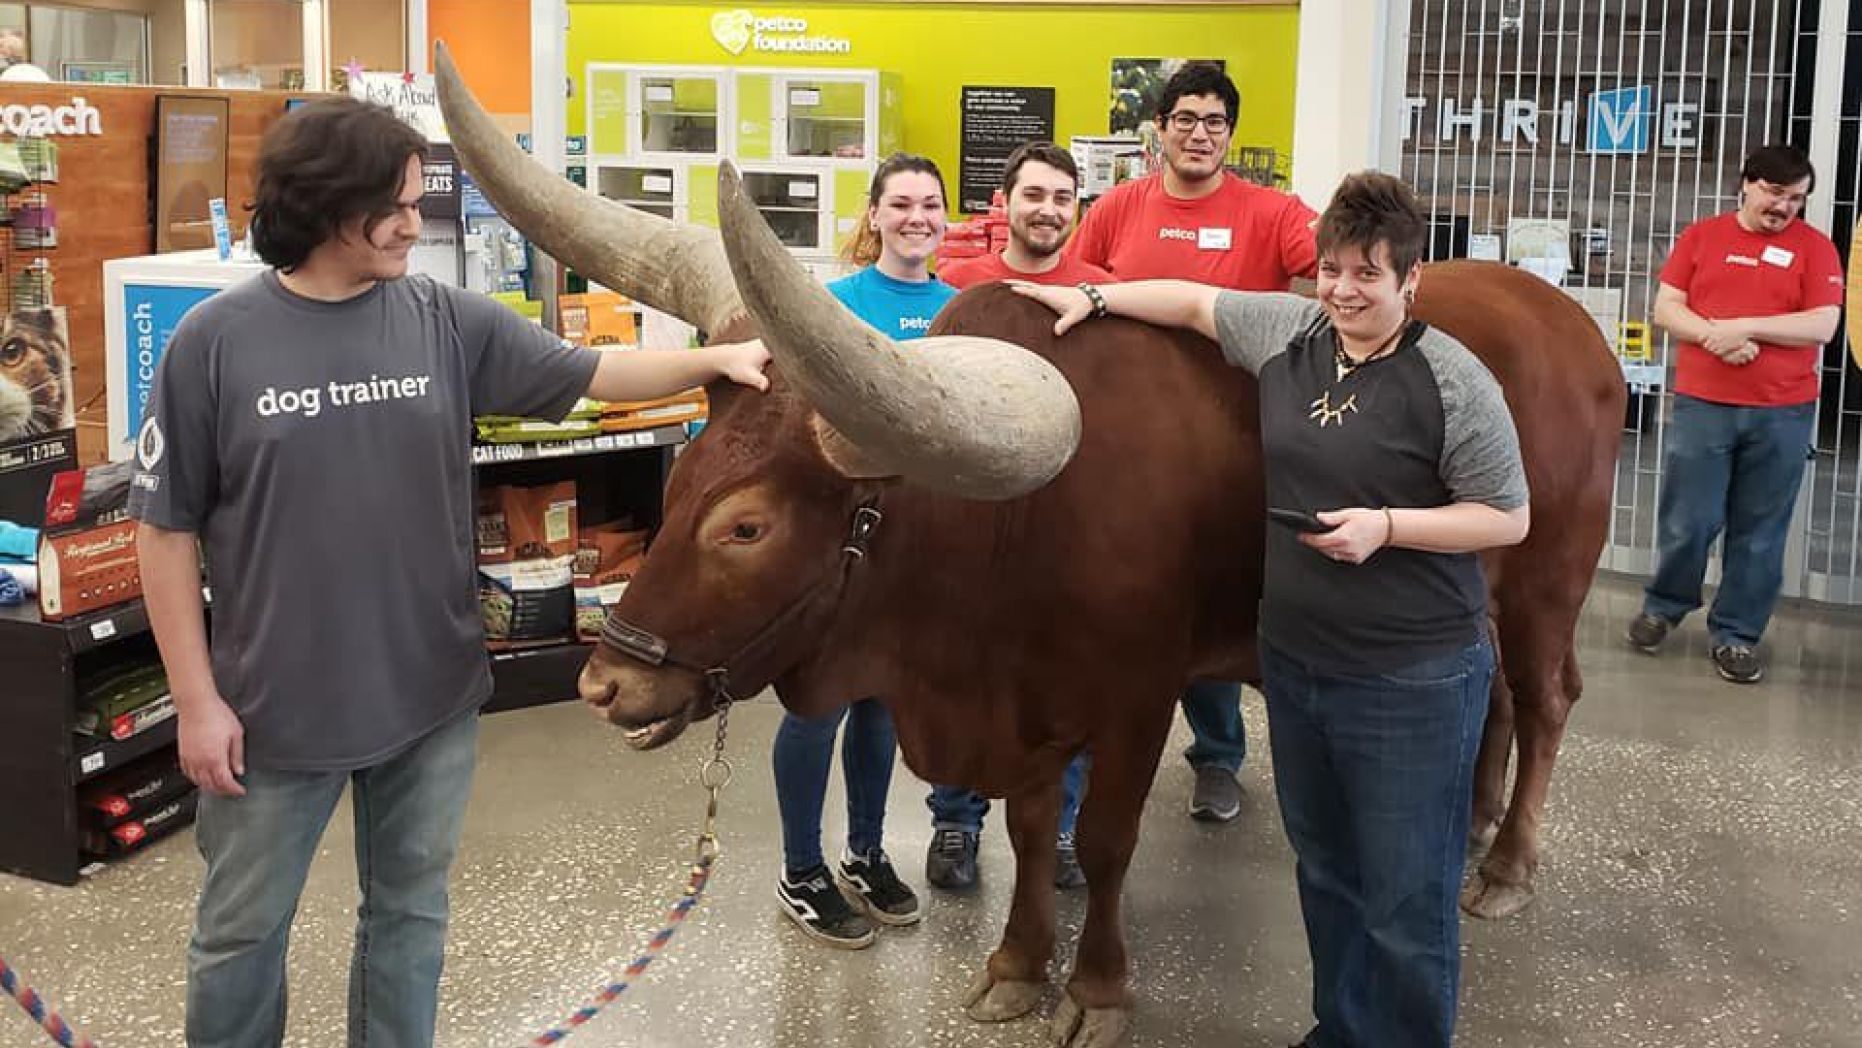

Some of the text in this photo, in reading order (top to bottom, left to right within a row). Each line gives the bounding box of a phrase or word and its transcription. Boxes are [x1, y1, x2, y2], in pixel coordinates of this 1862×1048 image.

[754, 17, 807, 32] petco
[754, 35, 851, 53] foundation
[0, 96, 103, 137] oach
[1401, 96, 1699, 148] THRIVE
[424, 176, 453, 193] EATS
[1159, 226, 1196, 241] petco
[899, 316, 931, 331] petc
[256, 374, 430, 418] dog trainer
[472, 446, 494, 463] CAT
